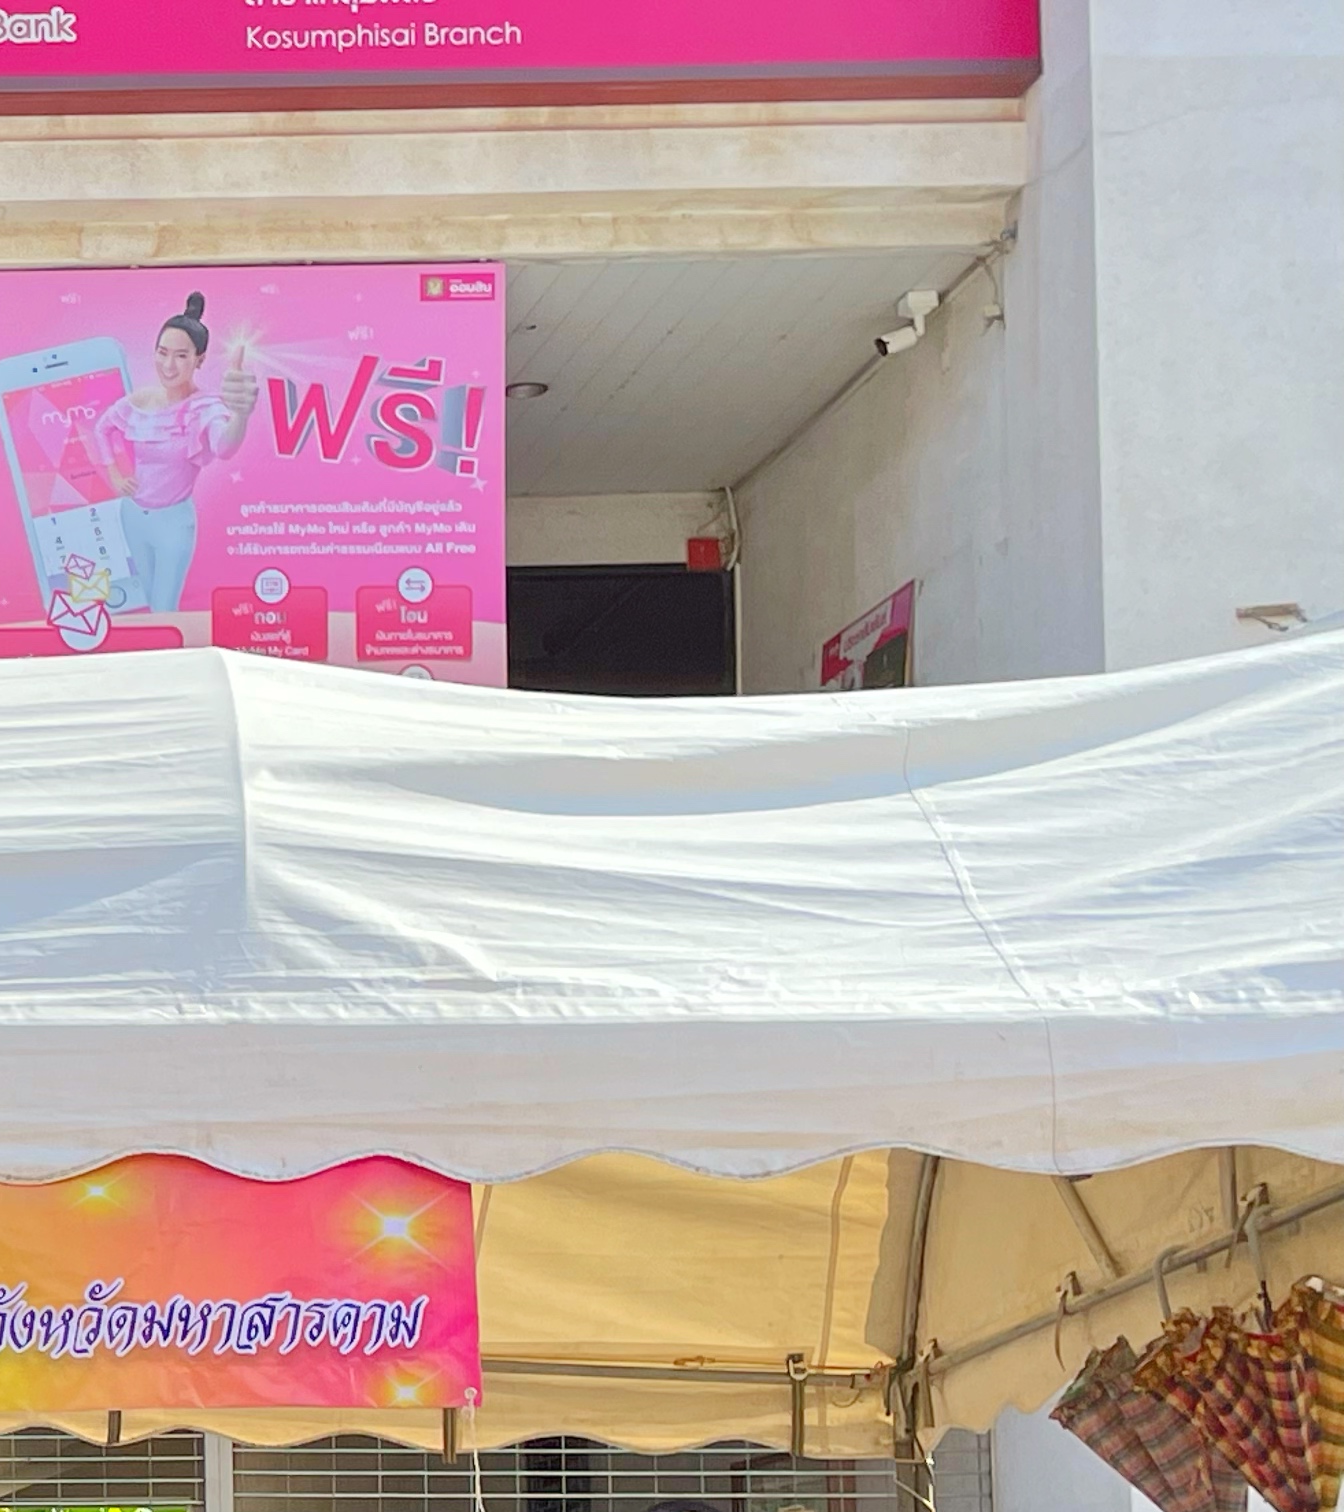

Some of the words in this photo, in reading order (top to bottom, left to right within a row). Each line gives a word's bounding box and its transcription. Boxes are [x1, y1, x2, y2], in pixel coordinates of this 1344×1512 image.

[245, 23, 416, 52] Kosumphisai
[424, 21, 522, 46] Branch
[265, 354, 488, 478] ฟรี!
[425, 542, 443, 554] All
[446, 542, 476, 554] Free
[400, 606, 428, 624] โอน
